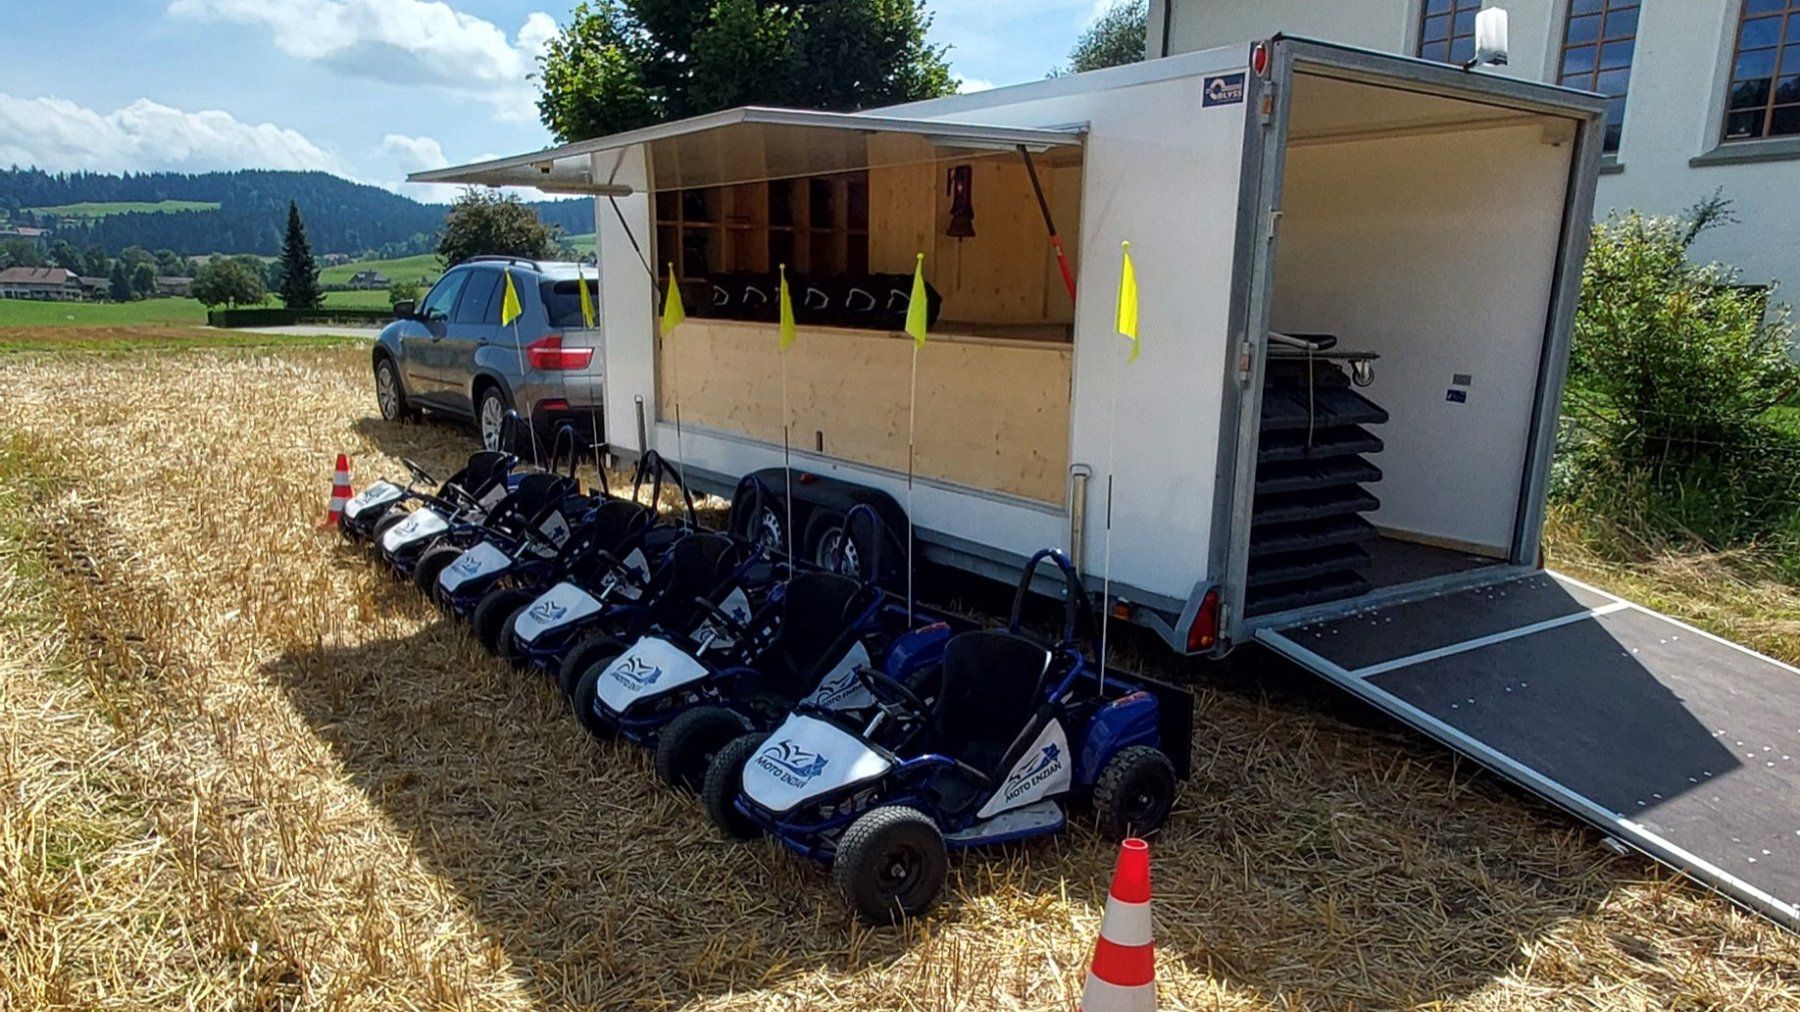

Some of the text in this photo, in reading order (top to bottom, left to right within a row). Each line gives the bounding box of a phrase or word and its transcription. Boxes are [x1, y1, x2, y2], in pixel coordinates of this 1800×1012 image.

[755, 756, 782, 777] MOTO
[1005, 761, 1062, 803] MOTO ENZIAN
